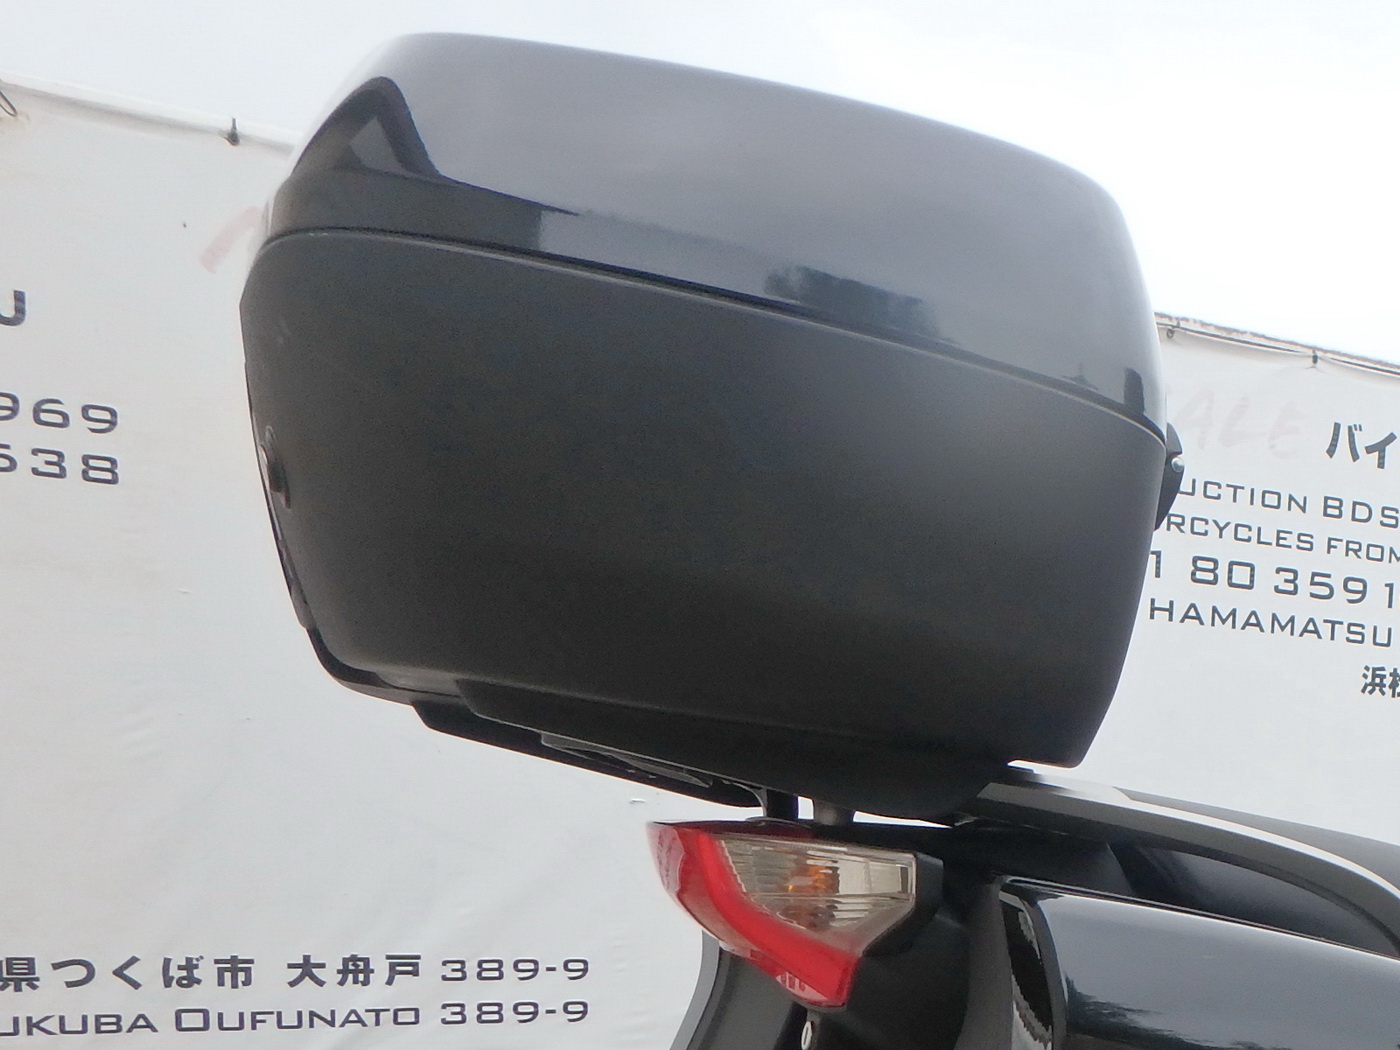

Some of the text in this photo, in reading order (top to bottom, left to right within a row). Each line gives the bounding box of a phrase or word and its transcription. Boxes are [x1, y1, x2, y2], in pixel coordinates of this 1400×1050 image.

[1322, 495, 1399, 529] BDS
[1190, 555, 1256, 591] 80
[1273, 566, 1368, 604] 359
[1149, 597, 1392, 648] HAMAMATSU
[440, 958, 589, 982] 389-9
[174, 1007, 420, 1033] OUFUNATO
[440, 1000, 589, 1026] 389-9
